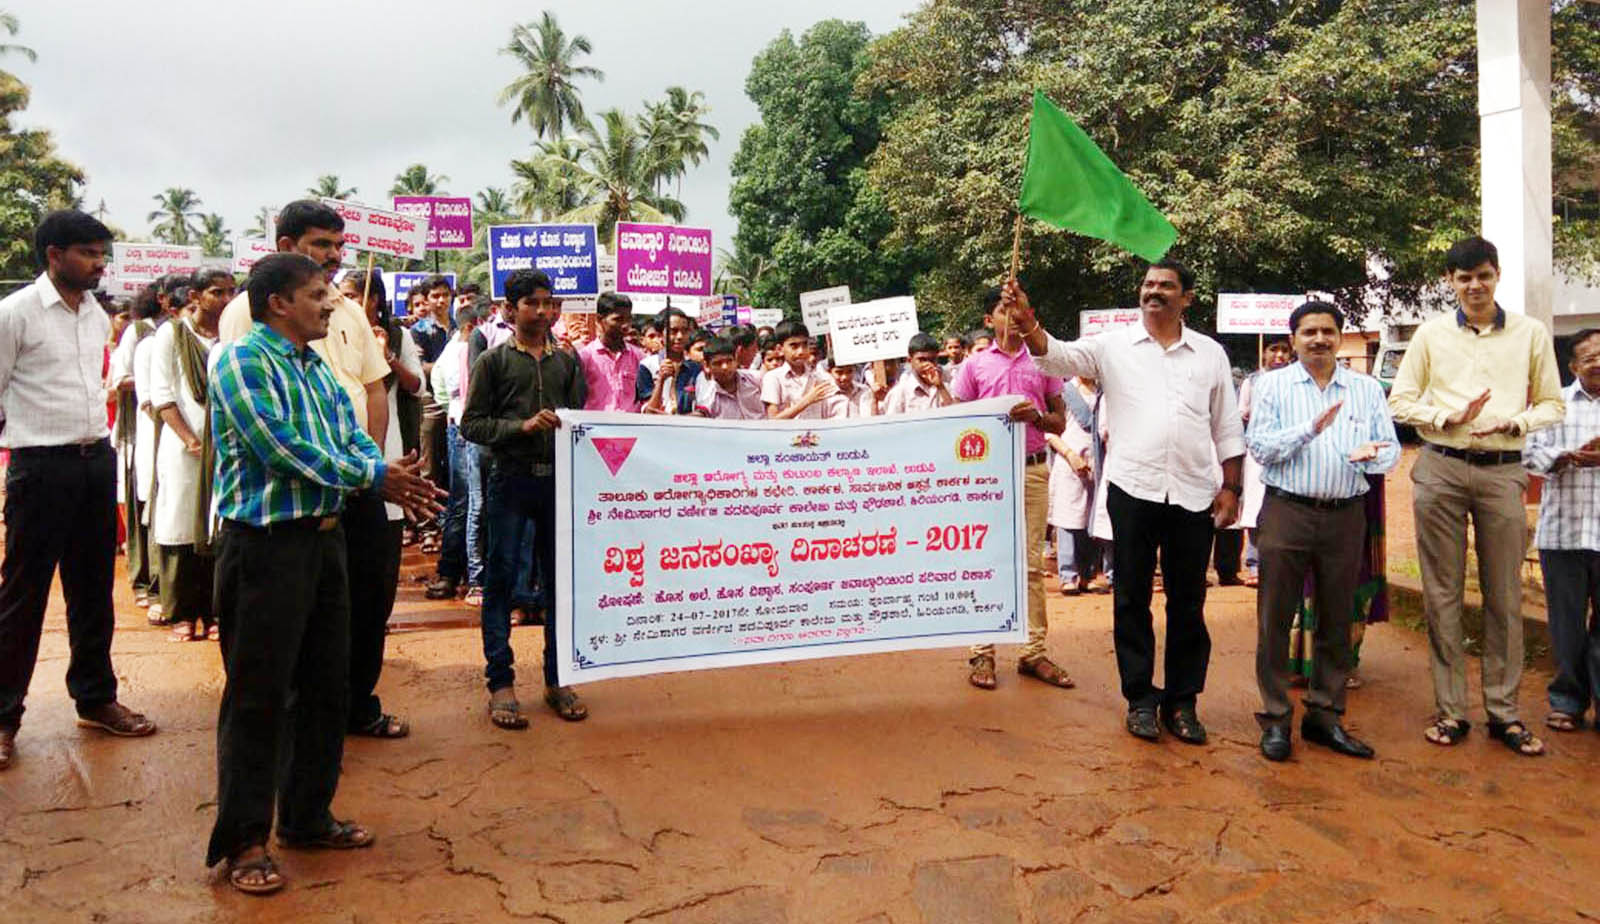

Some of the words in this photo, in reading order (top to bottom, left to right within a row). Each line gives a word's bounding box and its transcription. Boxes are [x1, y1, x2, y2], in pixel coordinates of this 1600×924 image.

[627, 264, 669, 287] ಯೋಜನೆ
[747, 453, 770, 466] ಜಿಲ್ಲಾ
[836, 448, 870, 461] ಉಡುಪಿ
[673, 472, 698, 486] ಜಿಲ್ಲಾ
[704, 470, 748, 487] ಆರೋಗ್ಯ
[753, 469, 778, 483] ಮತ್ತು
[783, 467, 822, 479] ಕುಟುಂಬ
[827, 465, 861, 483] ಕಲ್ಯಾಣ
[904, 461, 937, 475] ಉಡುಪಿ
[598, 490, 648, 502] ತಾಲೂಕು
[849, 480, 903, 495] ಸಾರ್ವಜನಿಕ
[936, 475, 970, 488] ಕಾರ್ಕಳ
[587, 509, 602, 525] ಶ್ರೀ
[608, 507, 672, 520] ನೇಮಿಸಾಗರ
[724, 502, 784, 518] ಪದವಿಪೂರ್ವ
[789, 500, 830, 514] ಕಾಲೇಜು
[835, 501, 858, 514] ಮತ್ತು
[966, 490, 1004, 502] ಕಾರ್ಕಳ
[603, 540, 646, 588] ವಿಶ್ವ
[659, 537, 780, 578] ಜನಸಂಖ್ಯಾ
[790, 526, 898, 562] ದಿನಾಚರಣೆ
[926, 524, 989, 552] 2017
[716, 585, 744, 600] ಹೊಸ
[788, 580, 836, 594] ಸಂಪೂರ್ಣ
[918, 570, 957, 584] ಪರಿವಾರ
[755, 602, 809, 617] ಸೋಮವಾರ
[841, 612, 864, 627] ಮತ್ತು
